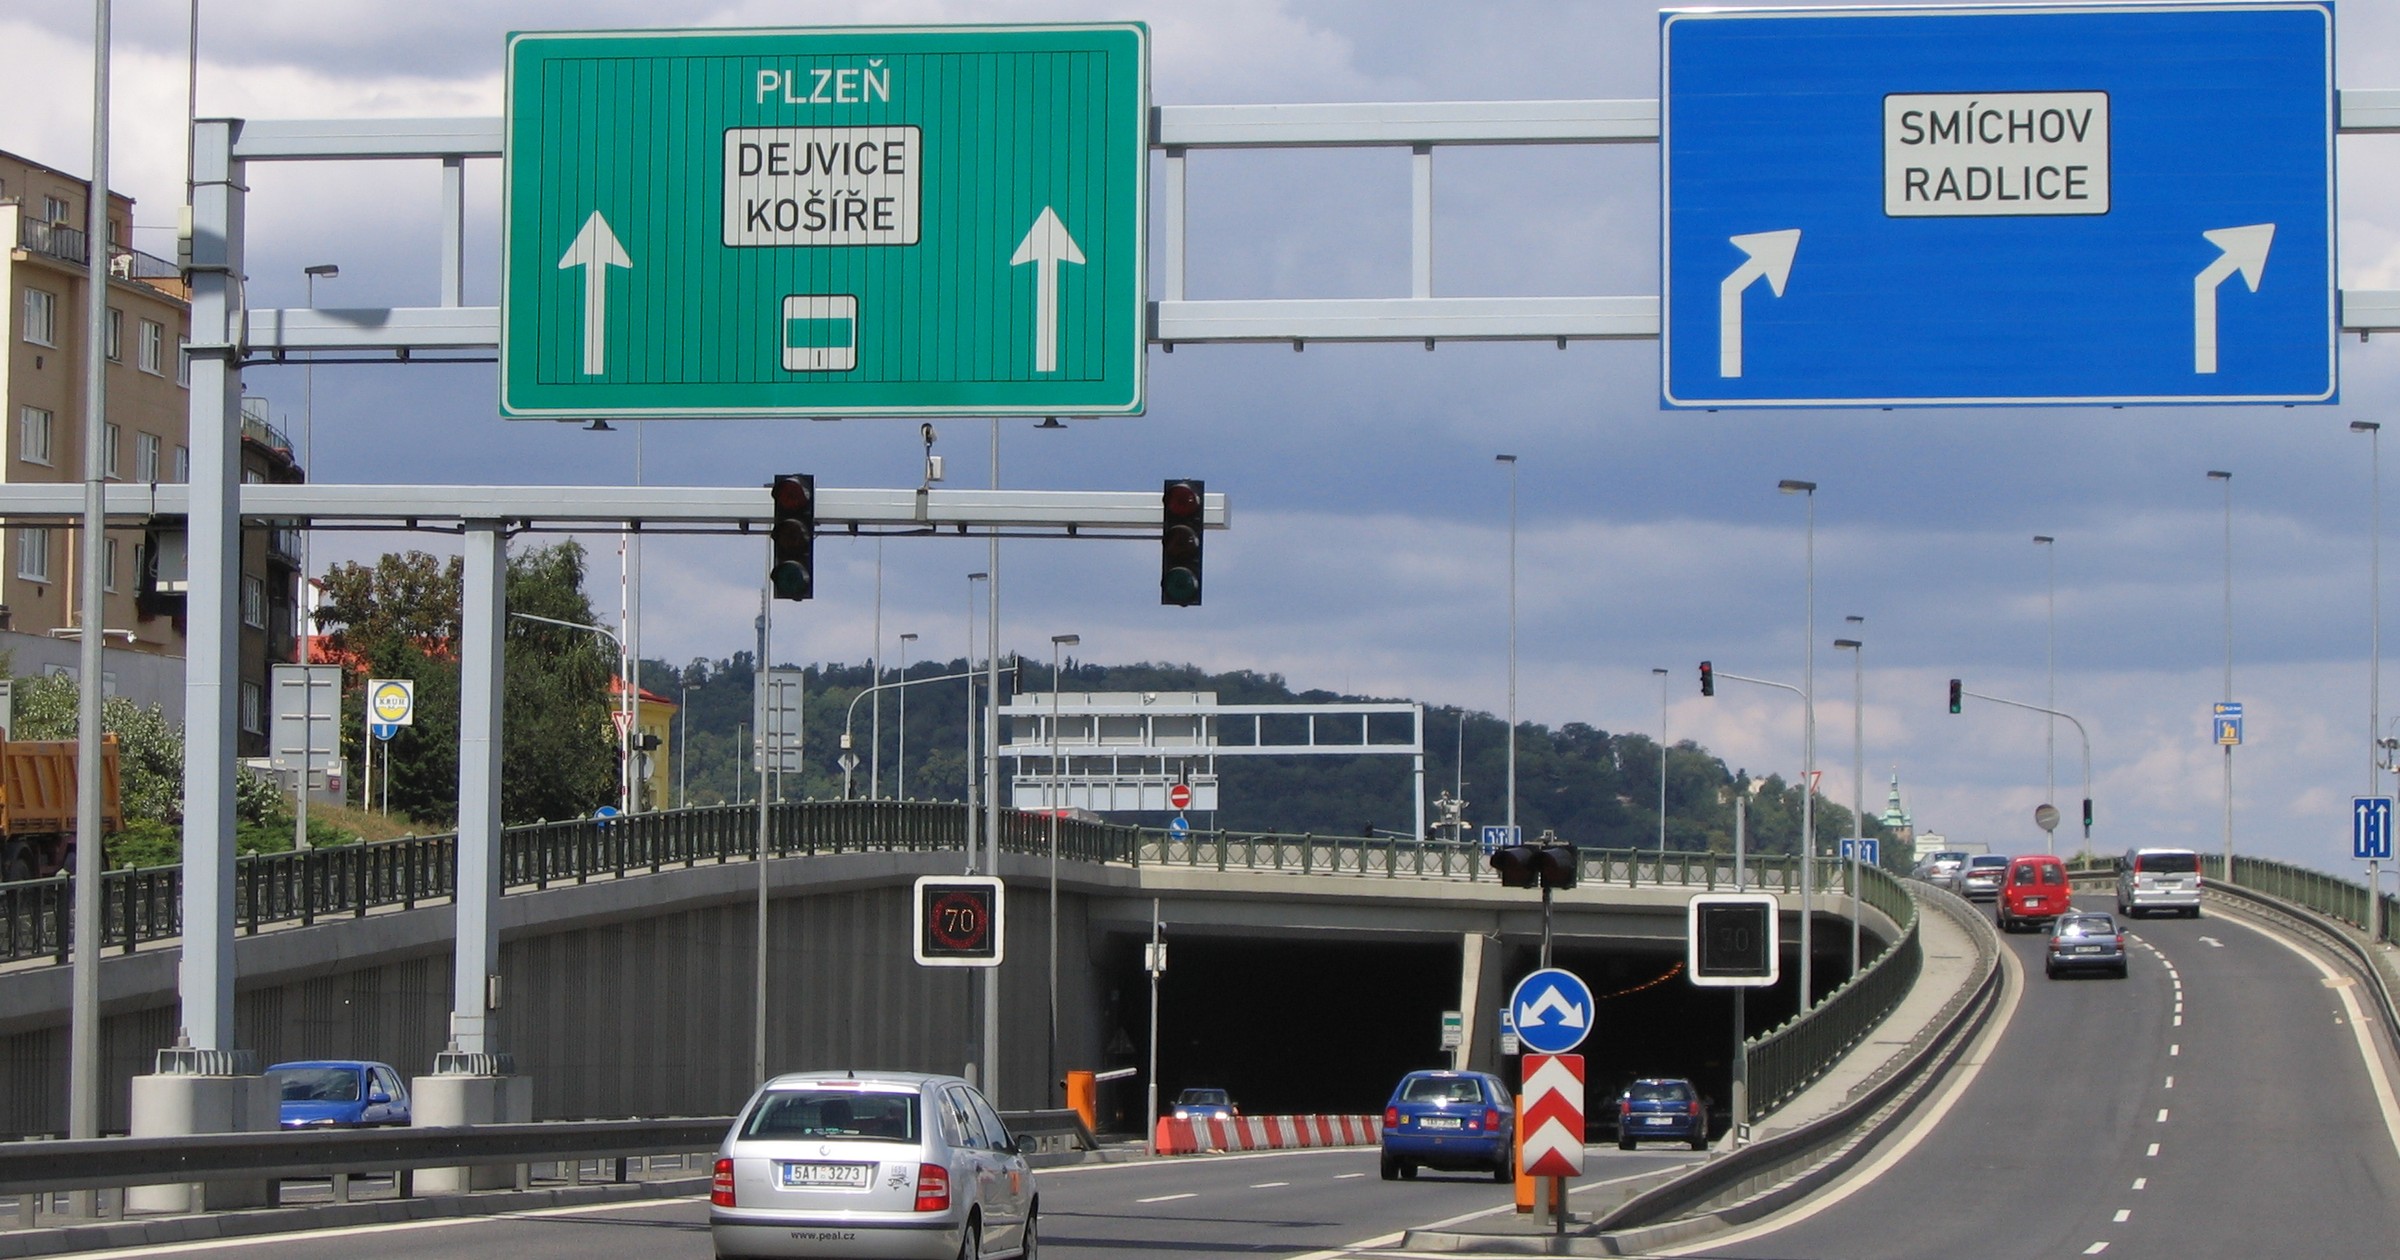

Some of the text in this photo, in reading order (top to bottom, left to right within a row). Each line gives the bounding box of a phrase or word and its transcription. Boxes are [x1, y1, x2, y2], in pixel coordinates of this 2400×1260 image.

[757, 58, 890, 104] PLZEŇ
[1901, 103, 2092, 144] SMÍCHOV
[739, 141, 905, 177] DEJVICE
[1905, 165, 2088, 202] RADLICE
[747, 190, 895, 232] KOŠÍŘE
[945, 908, 974, 932] 70
[795, 1166, 818, 1180] 5A1
[829, 1167, 860, 1181] 3273
[791, 1231, 855, 1242] www.peal.cz
